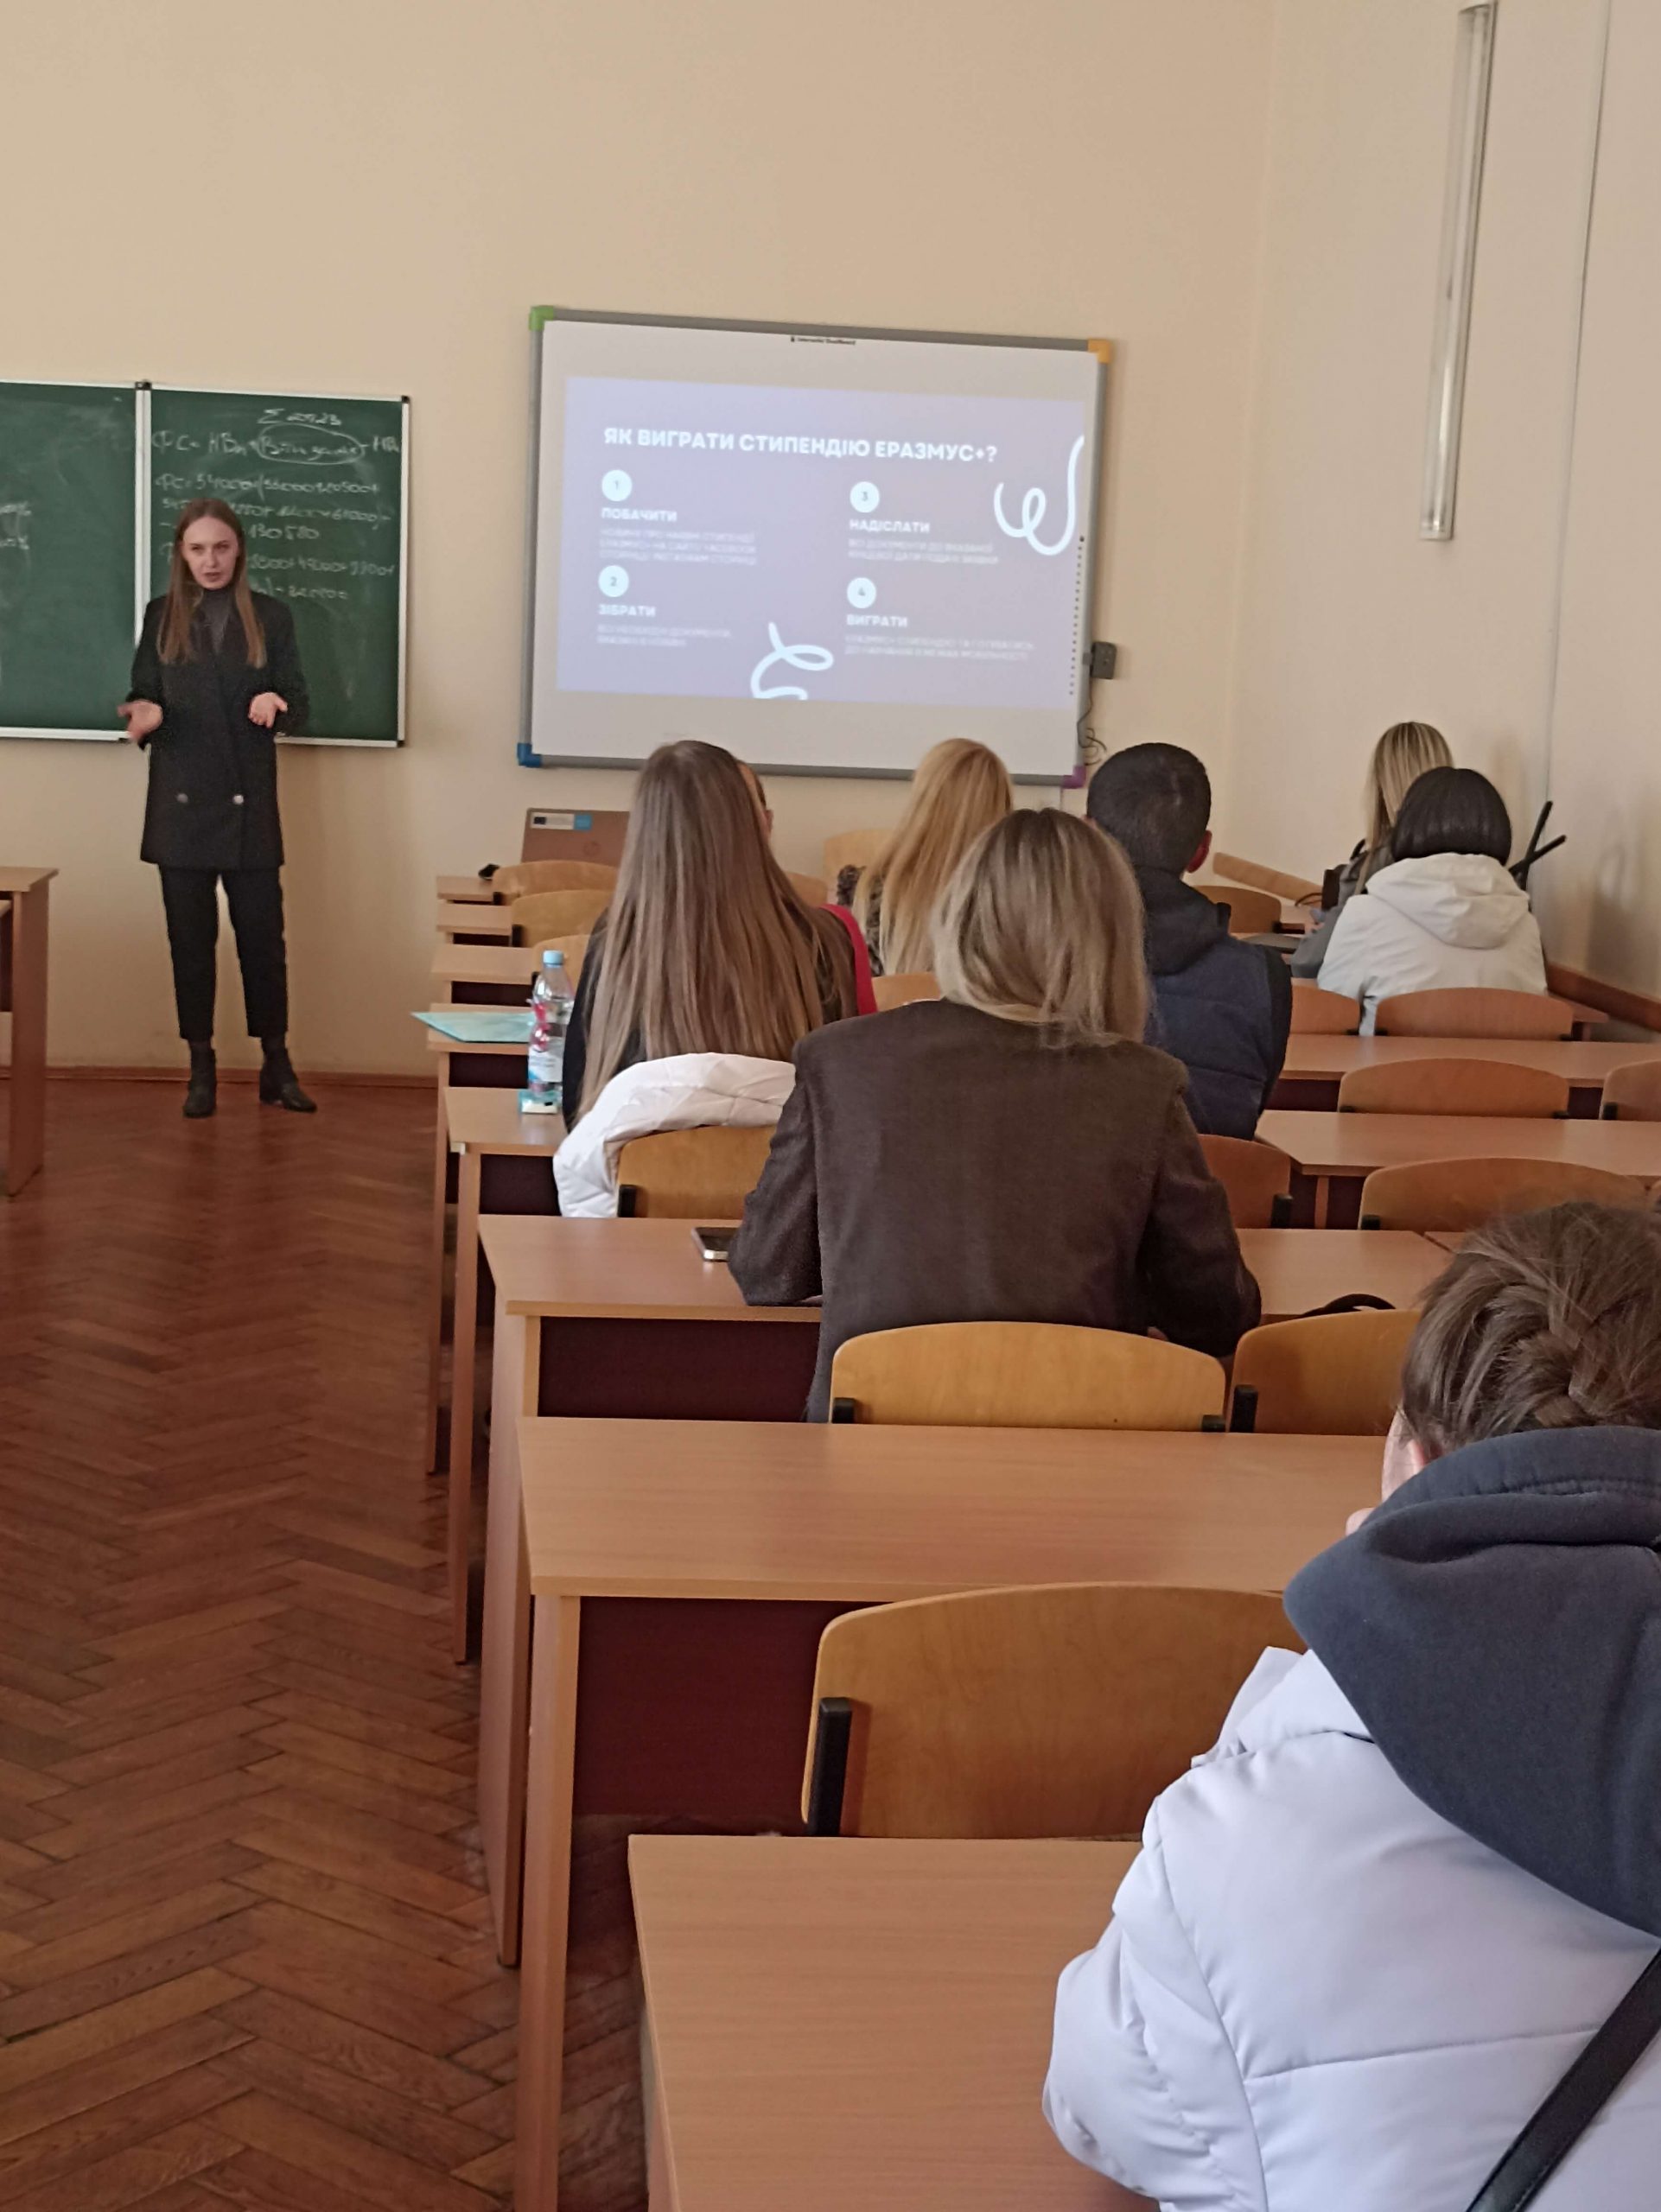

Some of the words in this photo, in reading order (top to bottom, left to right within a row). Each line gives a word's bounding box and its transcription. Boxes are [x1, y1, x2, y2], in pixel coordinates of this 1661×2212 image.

[604, 428, 632, 446] ЯК
[637, 429, 734, 450] ВИГРАТИ
[739, 433, 870, 458] СТИПЕНДІЮ
[875, 441, 997, 463] ЕРАЗМУС+?
[601, 507, 678, 522] ПОБАЧИТИ
[849, 518, 931, 533] НАДІСЛАТИ
[598, 603, 656, 617] ЗІБРАТИ
[846, 614, 907, 627] ВИГРАТИ
